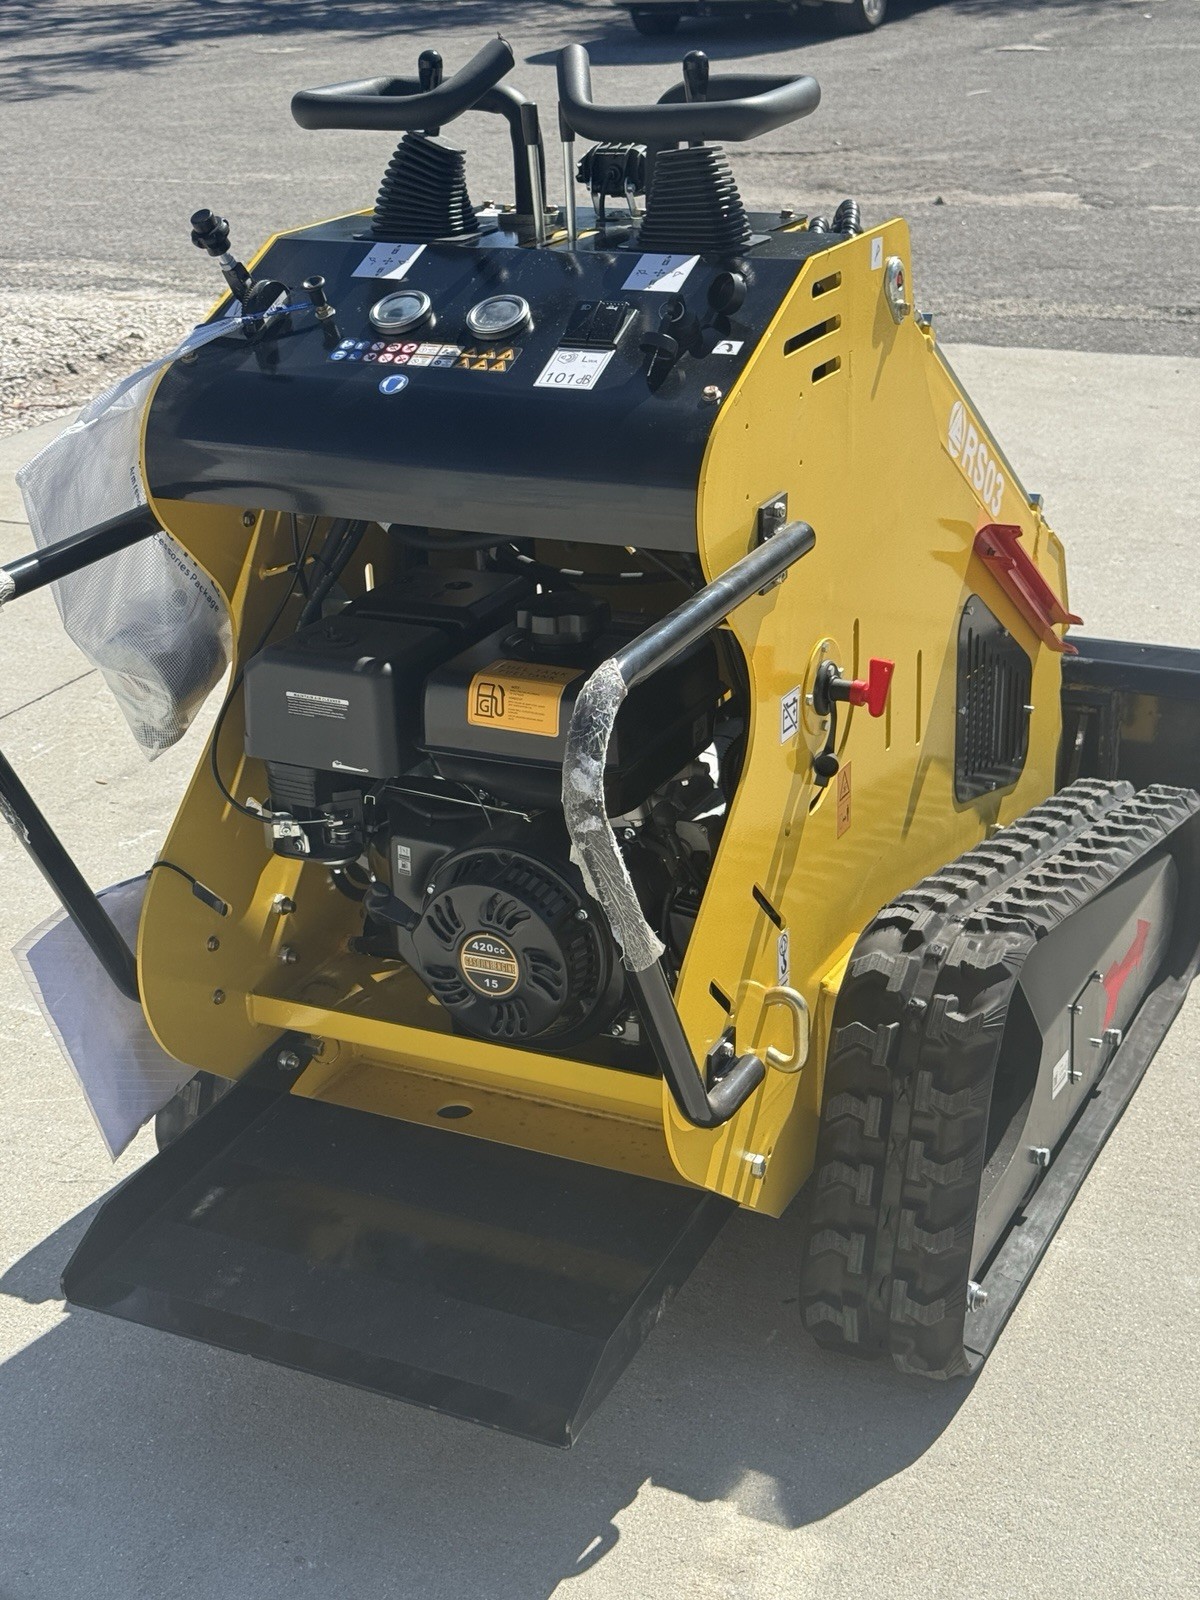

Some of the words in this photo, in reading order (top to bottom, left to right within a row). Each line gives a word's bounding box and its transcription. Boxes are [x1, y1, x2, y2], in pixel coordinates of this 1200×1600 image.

[546, 371, 575, 384] 101
[575, 374, 592, 385] dB
[961, 423, 1005, 517] RS03
[152, 532, 190, 577] cessories
[189, 572, 220, 613] Package
[472, 941, 506, 955] 420cc
[484, 978, 499, 989] 15
